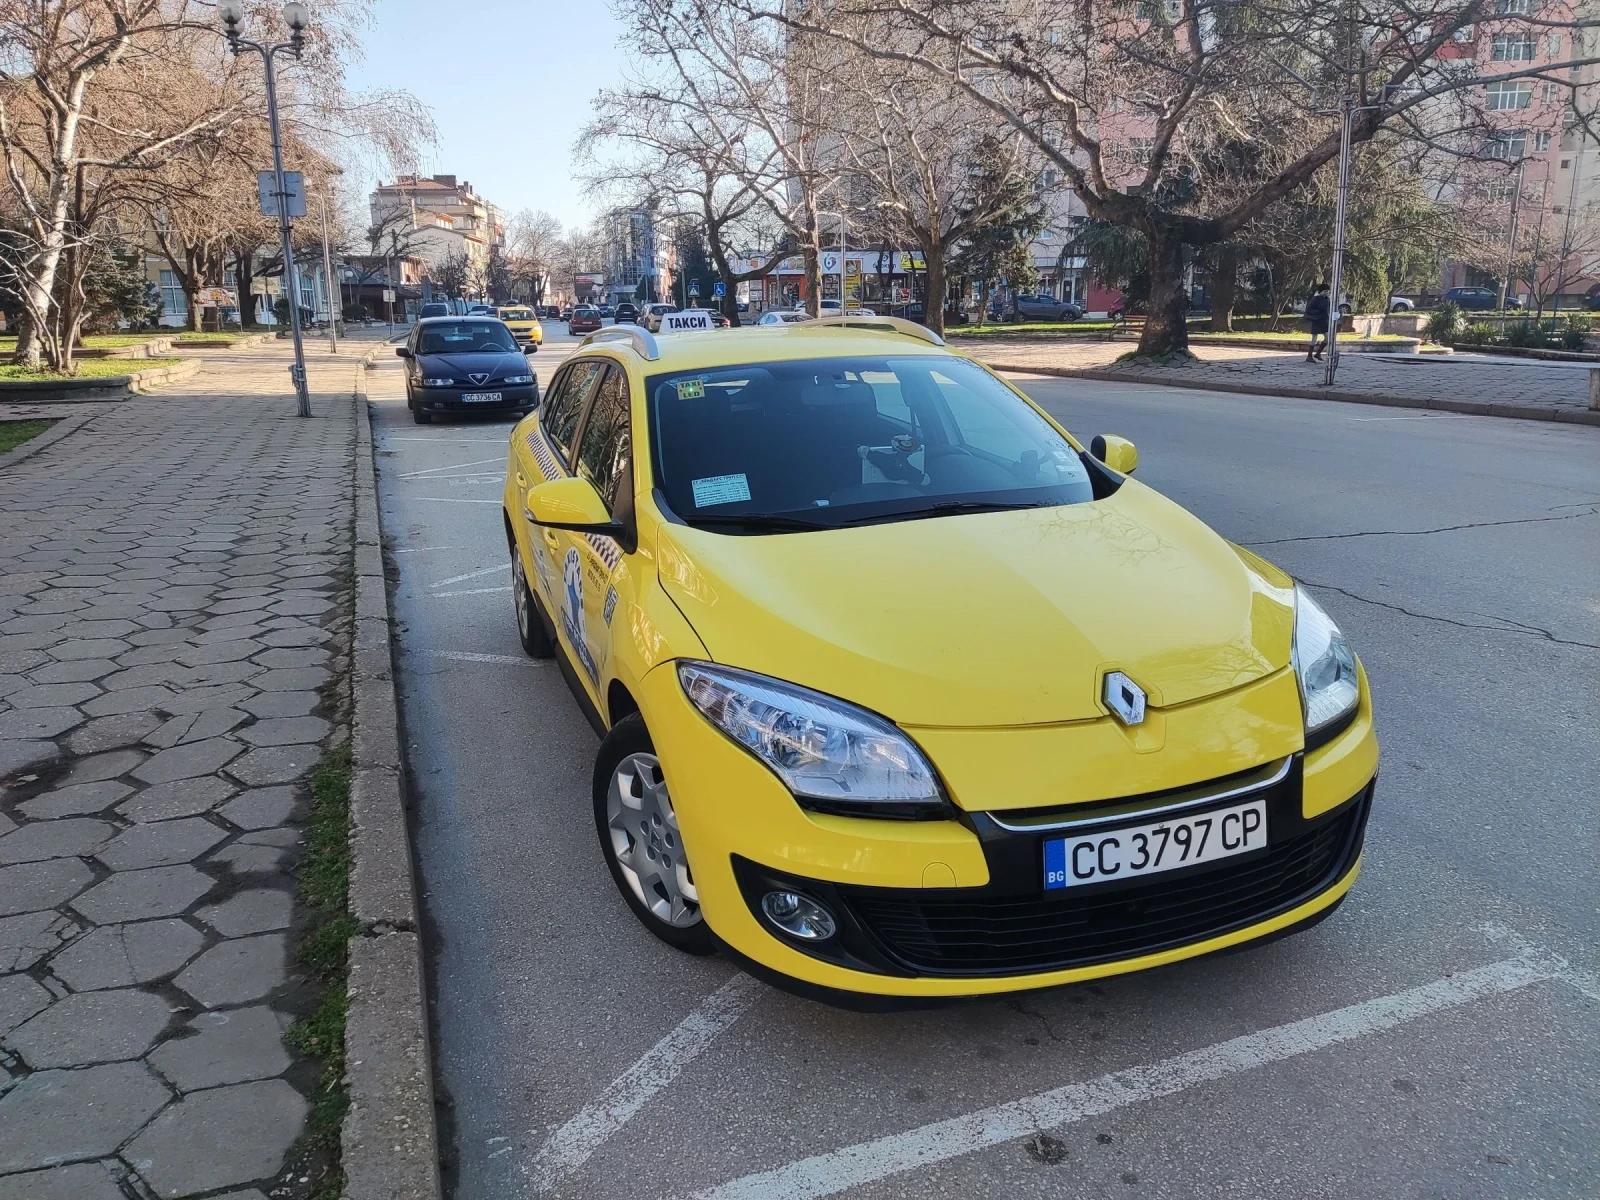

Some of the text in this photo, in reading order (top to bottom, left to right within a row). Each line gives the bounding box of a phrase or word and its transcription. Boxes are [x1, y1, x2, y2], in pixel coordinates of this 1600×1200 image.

[667, 316, 707, 329] ТАКСИ
[680, 381, 701, 389] TAXI
[683, 391, 700, 399] LED
[1072, 808, 1261, 880] CC 3797 CP
[1048, 871, 1065, 884] BG
